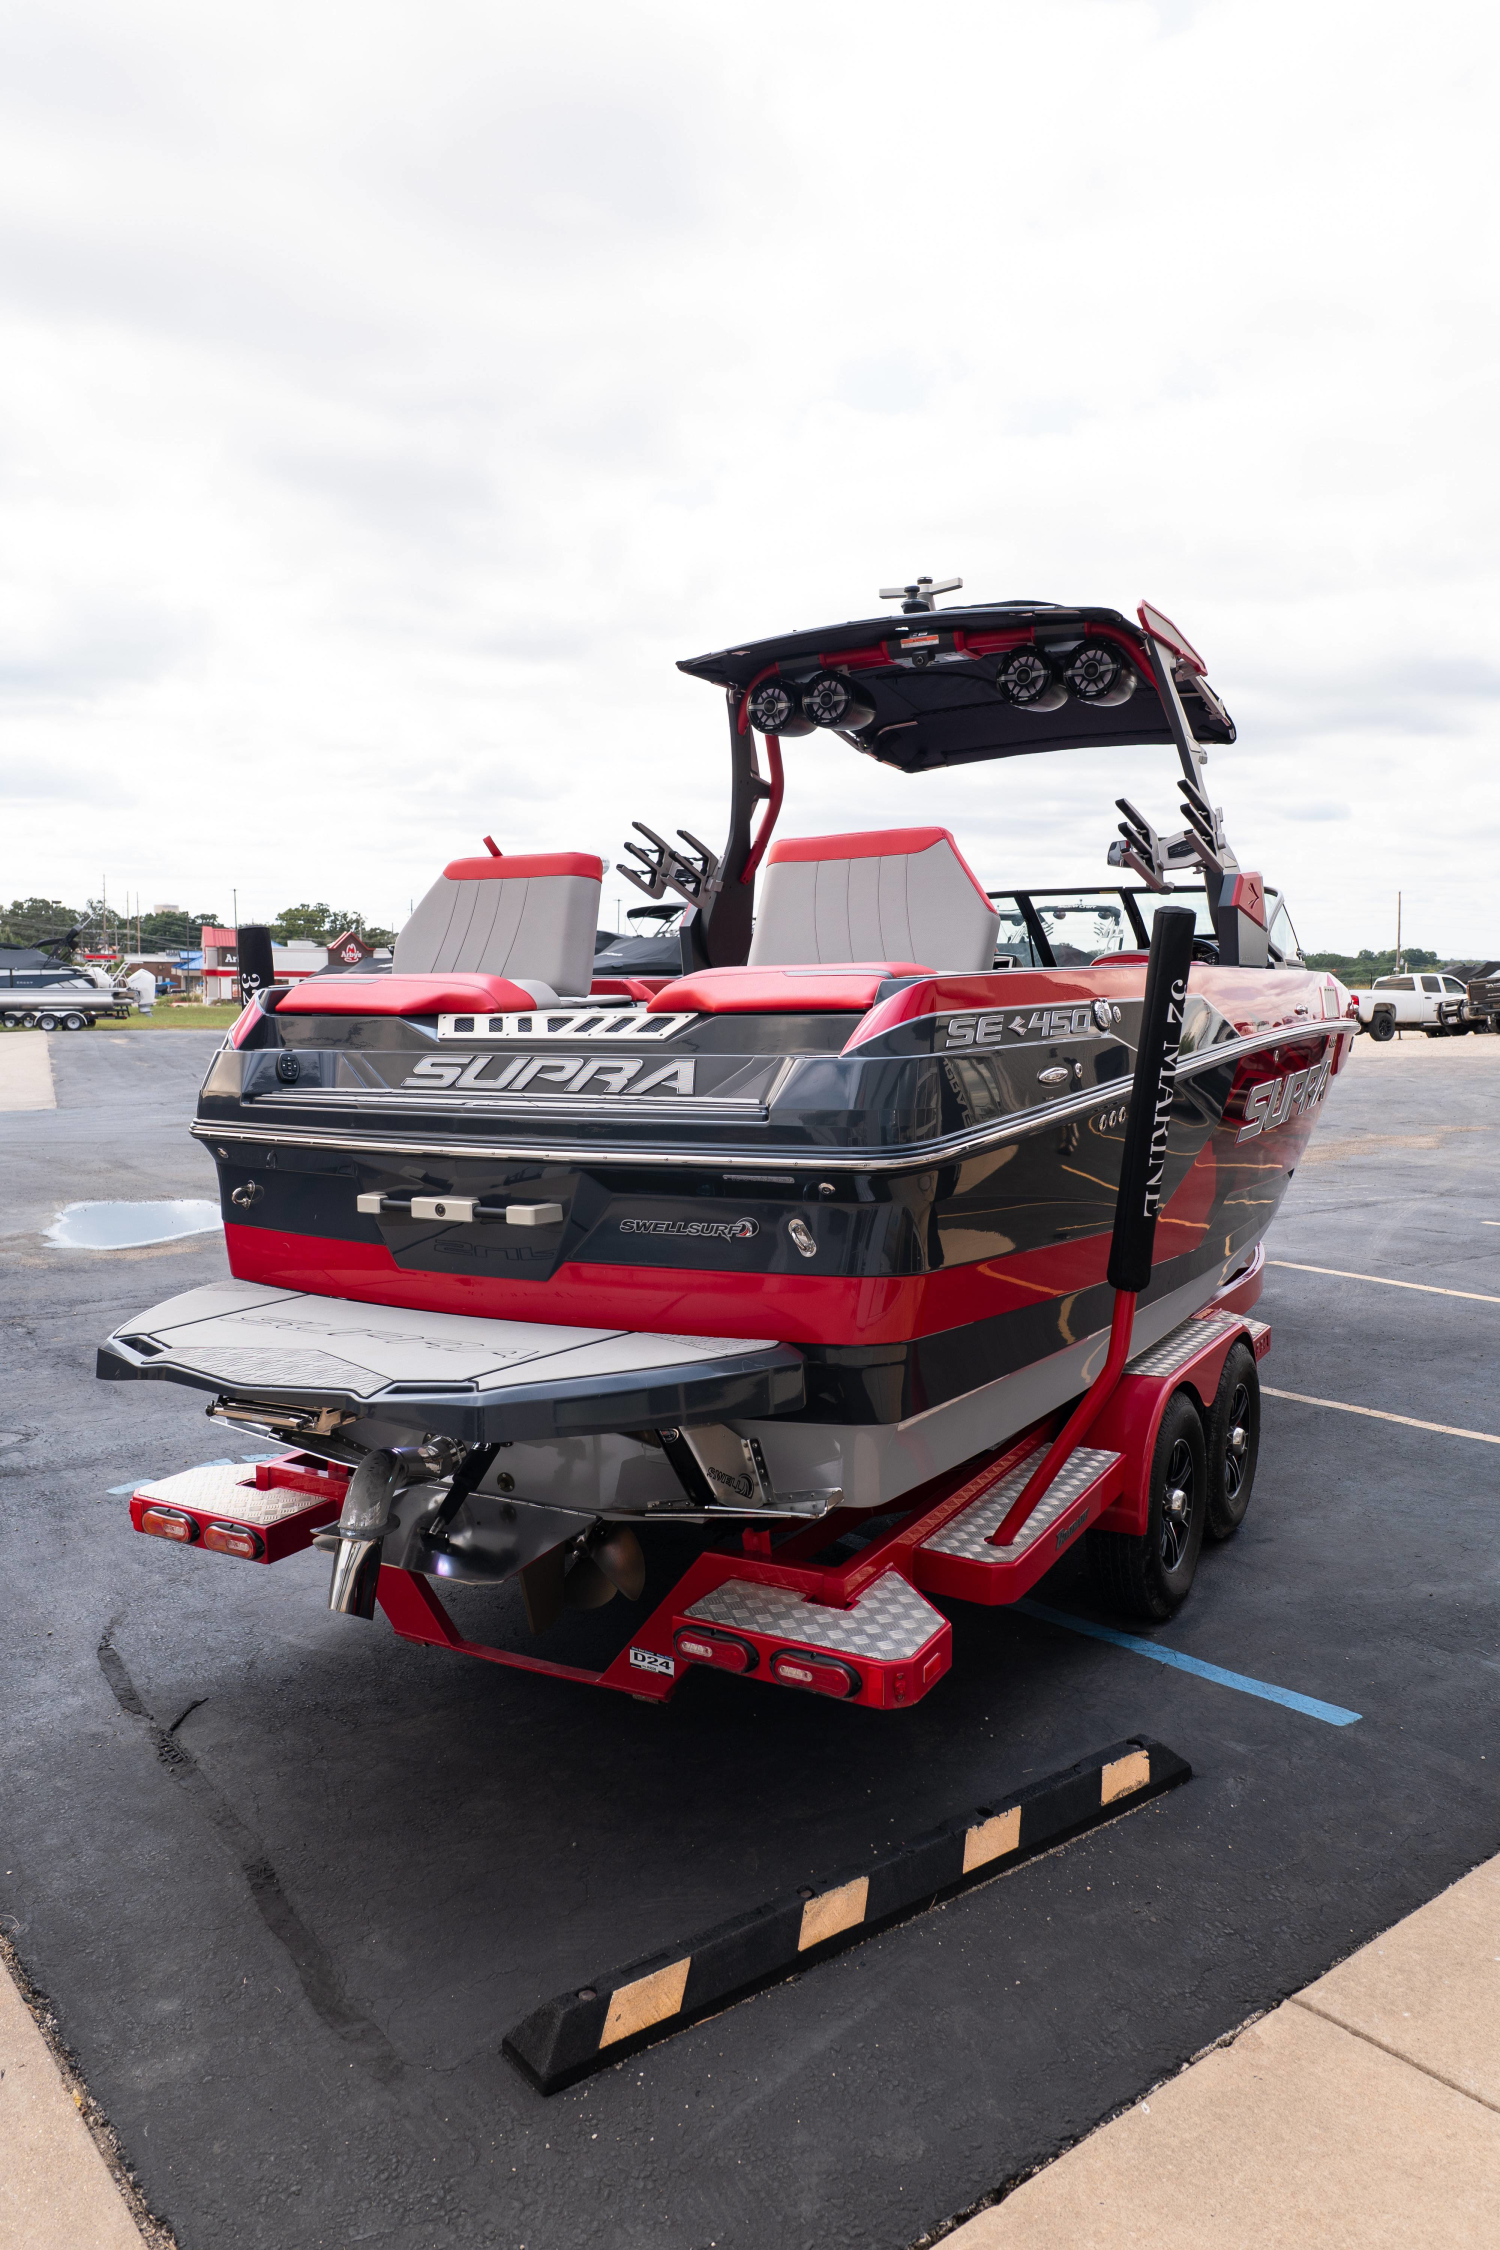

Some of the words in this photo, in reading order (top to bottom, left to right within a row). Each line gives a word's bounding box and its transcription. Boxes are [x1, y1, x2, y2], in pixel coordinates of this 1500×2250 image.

[946, 1014, 1004, 1048] SE
[1028, 1008, 1092, 1037] 450
[401, 1054, 697, 1096] SUPRA
[1235, 1060, 1332, 1143] SUPRA
[1143, 1040, 1181, 1217] MARINE
[620, 1219, 744, 1243] SWELLSURF
[633, 1651, 671, 1671] D24
